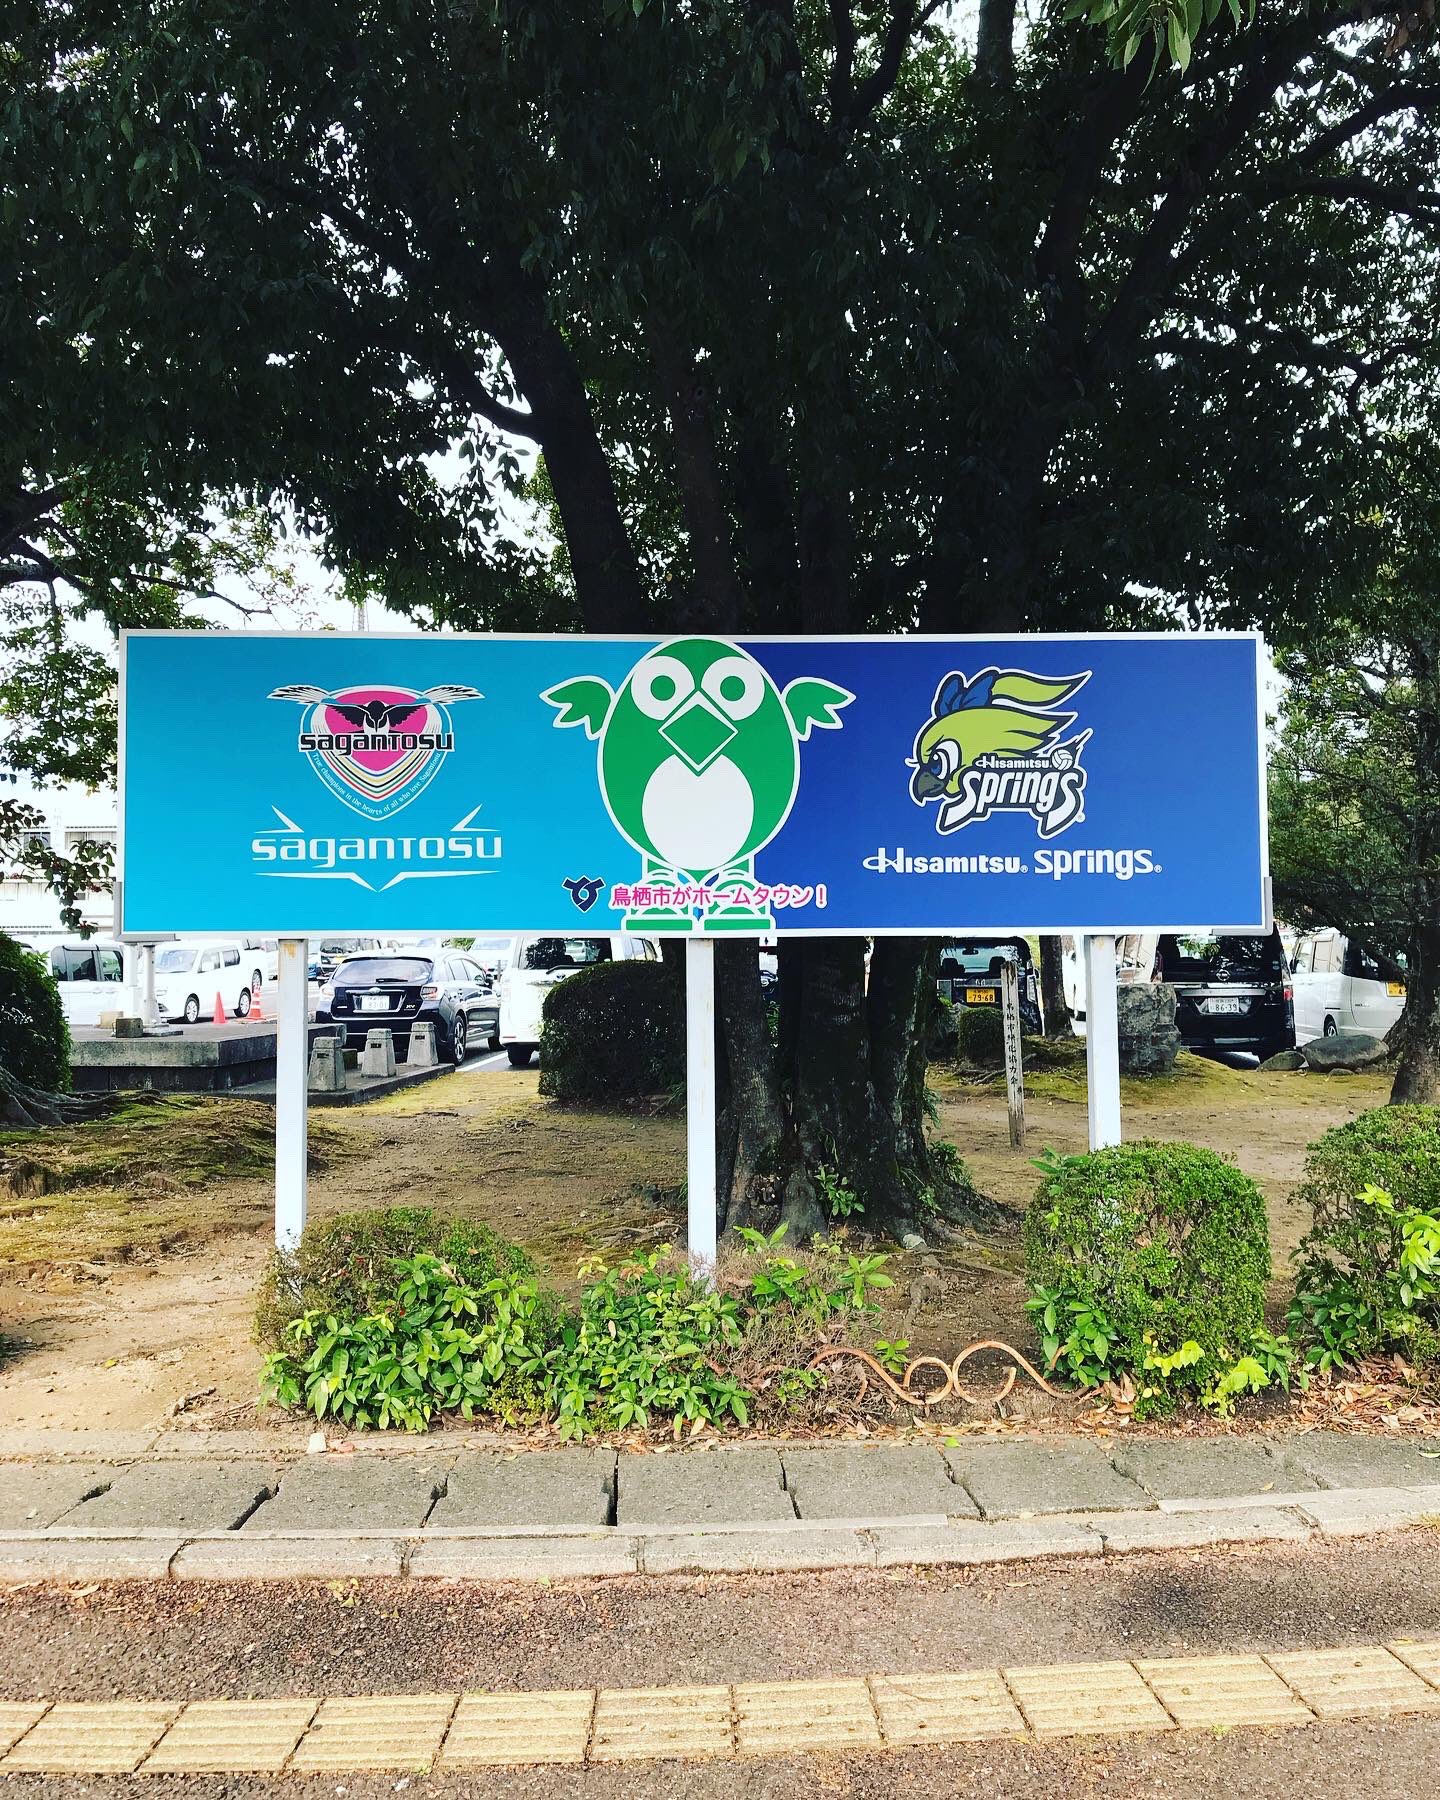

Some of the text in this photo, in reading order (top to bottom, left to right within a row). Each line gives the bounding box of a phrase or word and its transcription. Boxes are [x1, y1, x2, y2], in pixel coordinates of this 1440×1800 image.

[312, 752, 323, 768] True
[321, 767, 346, 795] champions
[351, 797, 362, 807] the
[361, 803, 382, 816] hearts
[383, 804, 391, 813] of
[390, 799, 399, 809] all
[398, 791, 411, 802] who
[409, 781, 421, 793] love
[419, 752, 442, 783] Sagantosu
